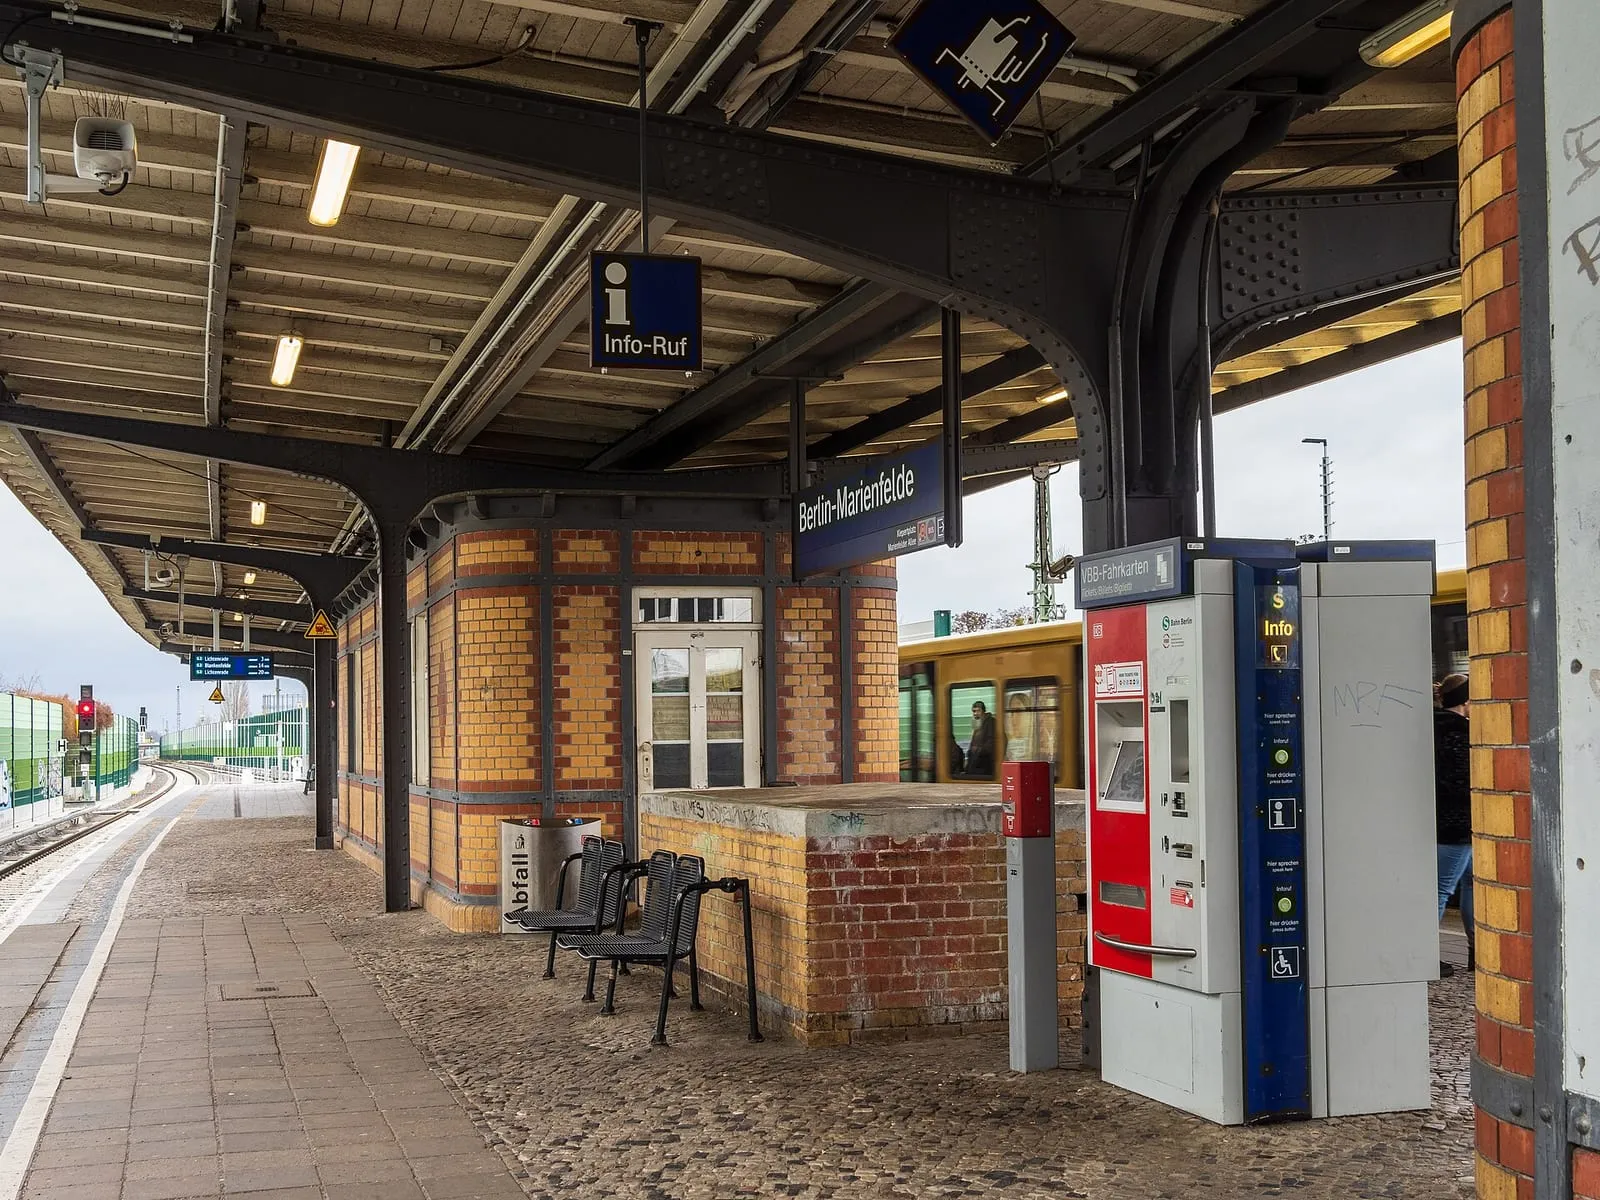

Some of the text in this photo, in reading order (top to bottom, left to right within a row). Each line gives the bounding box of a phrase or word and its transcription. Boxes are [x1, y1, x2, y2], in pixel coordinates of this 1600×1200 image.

[605, 333, 687, 356] Info-Ruf
[799, 464, 914, 533] Berlin-Marienfelde
[1081, 560, 1149, 583] VBB-Fahrkarten
[1181, 616, 1192, 626] Berlin
[1265, 620, 1293, 636] Info
[58, 740, 66, 752] H
